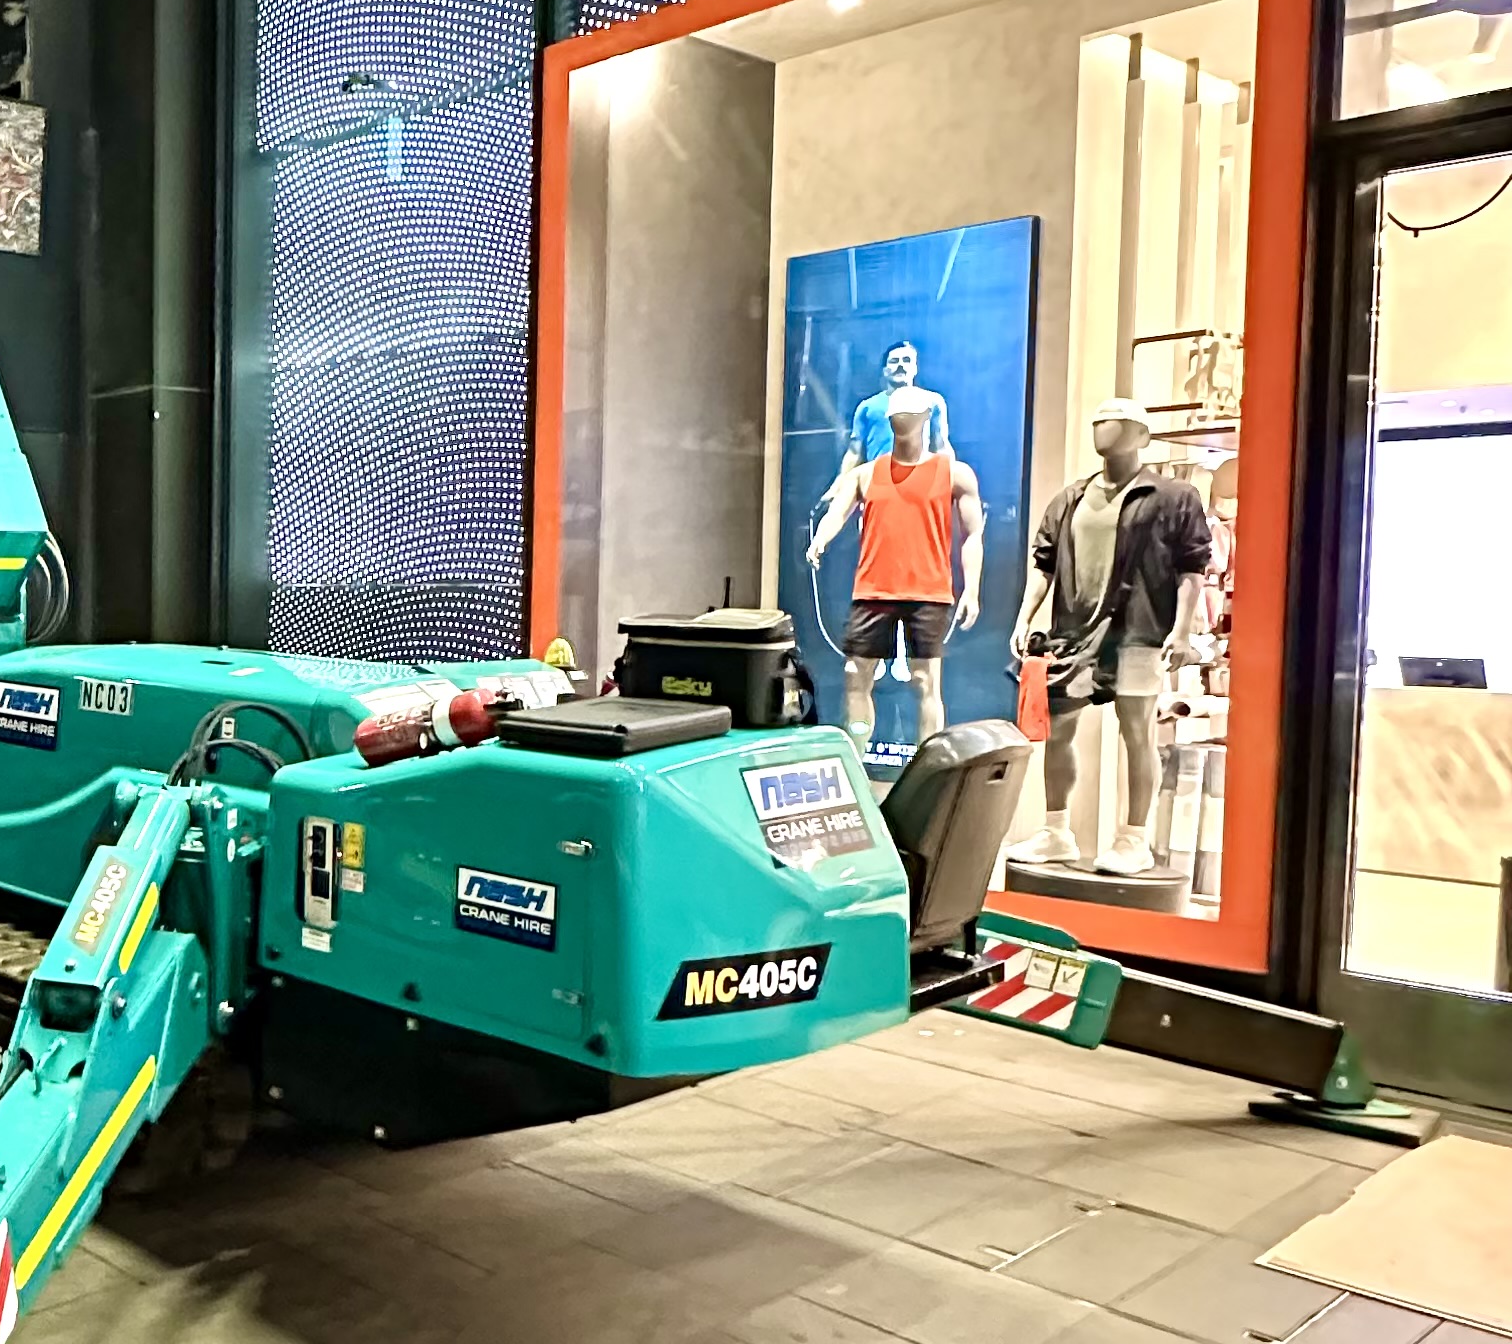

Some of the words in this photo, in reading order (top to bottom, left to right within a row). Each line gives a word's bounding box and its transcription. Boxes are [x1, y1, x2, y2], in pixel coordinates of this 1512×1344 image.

[30, 723, 55, 737] HIRE
[766, 817, 825, 843] CRANE
[823, 810, 864, 832] HIRE
[75, 864, 127, 944] MC405C
[459, 904, 510, 925] CRANE
[514, 916, 552, 936] HIRE
[685, 956, 818, 1006] MC405C
